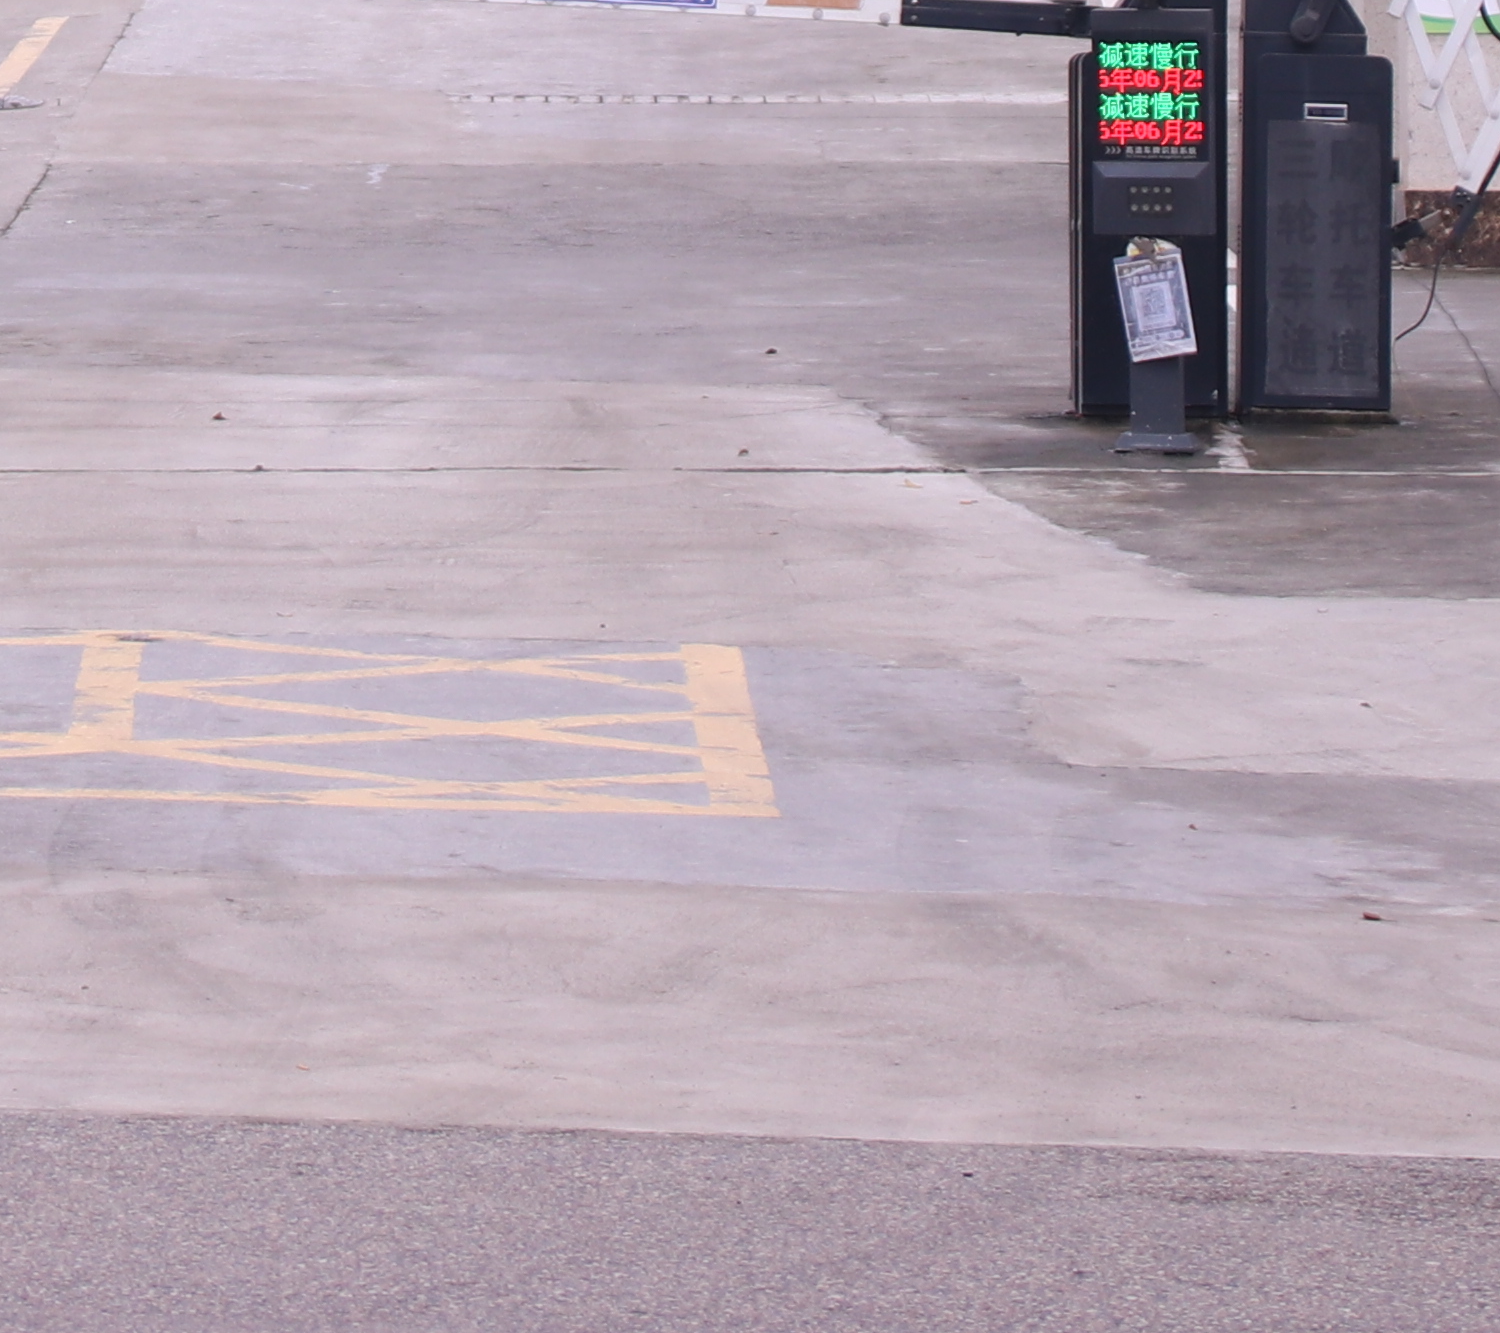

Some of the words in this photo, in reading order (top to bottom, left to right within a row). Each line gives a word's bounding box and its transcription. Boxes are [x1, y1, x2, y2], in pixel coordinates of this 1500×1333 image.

[1099, 42, 1199, 69] 减速慢行
[1099, 93, 1200, 119] 减速慢行
